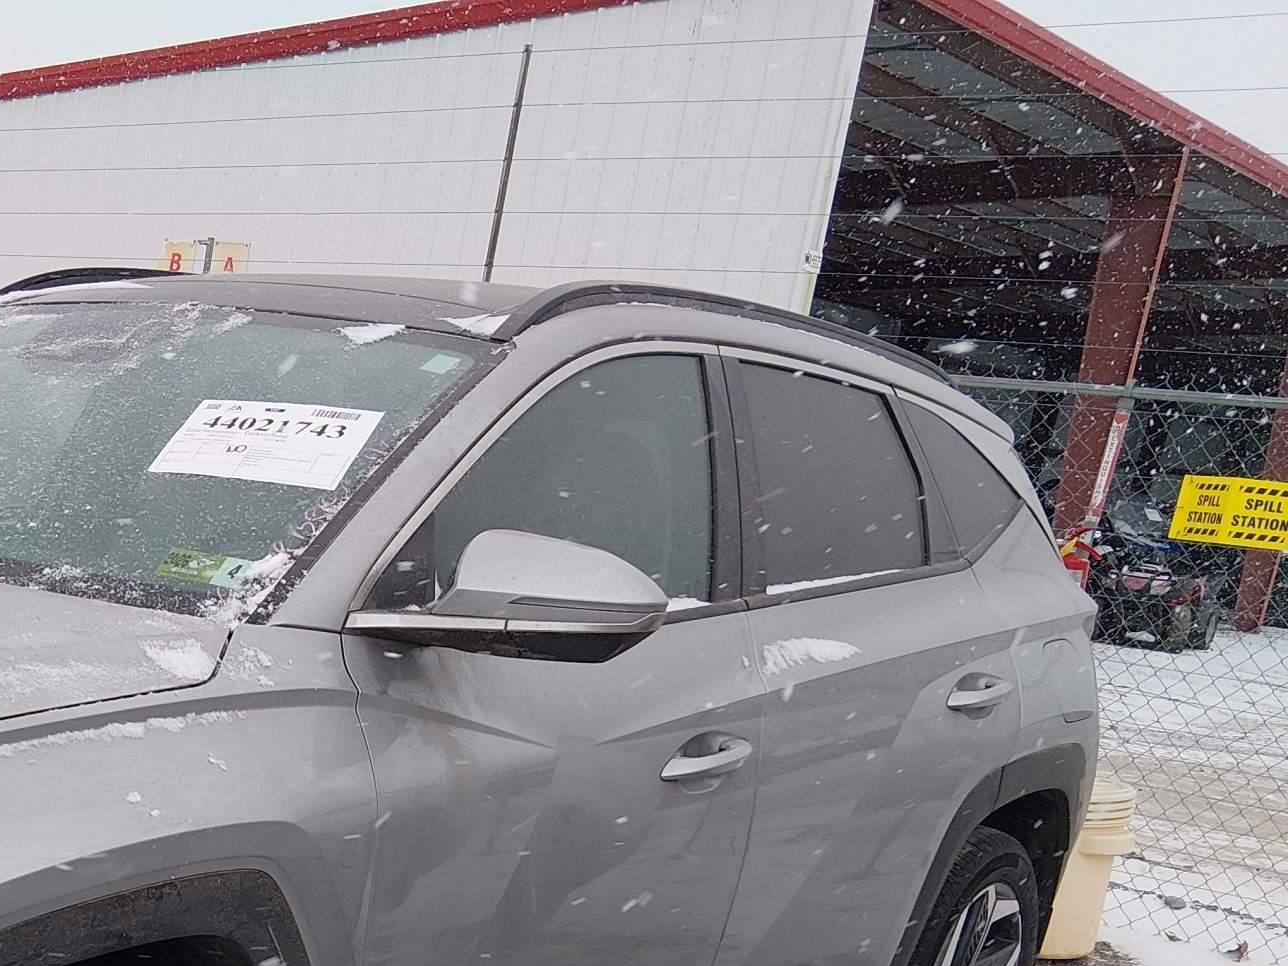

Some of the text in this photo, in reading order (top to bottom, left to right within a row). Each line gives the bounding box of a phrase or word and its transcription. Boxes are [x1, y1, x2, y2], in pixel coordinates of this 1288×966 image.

[169, 252, 182, 272] B
[223, 256, 234, 273] A
[203, 415, 347, 438] 44021743
[1197, 494, 1221, 508] SPILL
[1244, 498, 1284, 514] SPILL
[1187, 511, 1223, 525] STATION
[1231, 514, 1288, 532] STATION
[227, 564, 244, 580] 4
